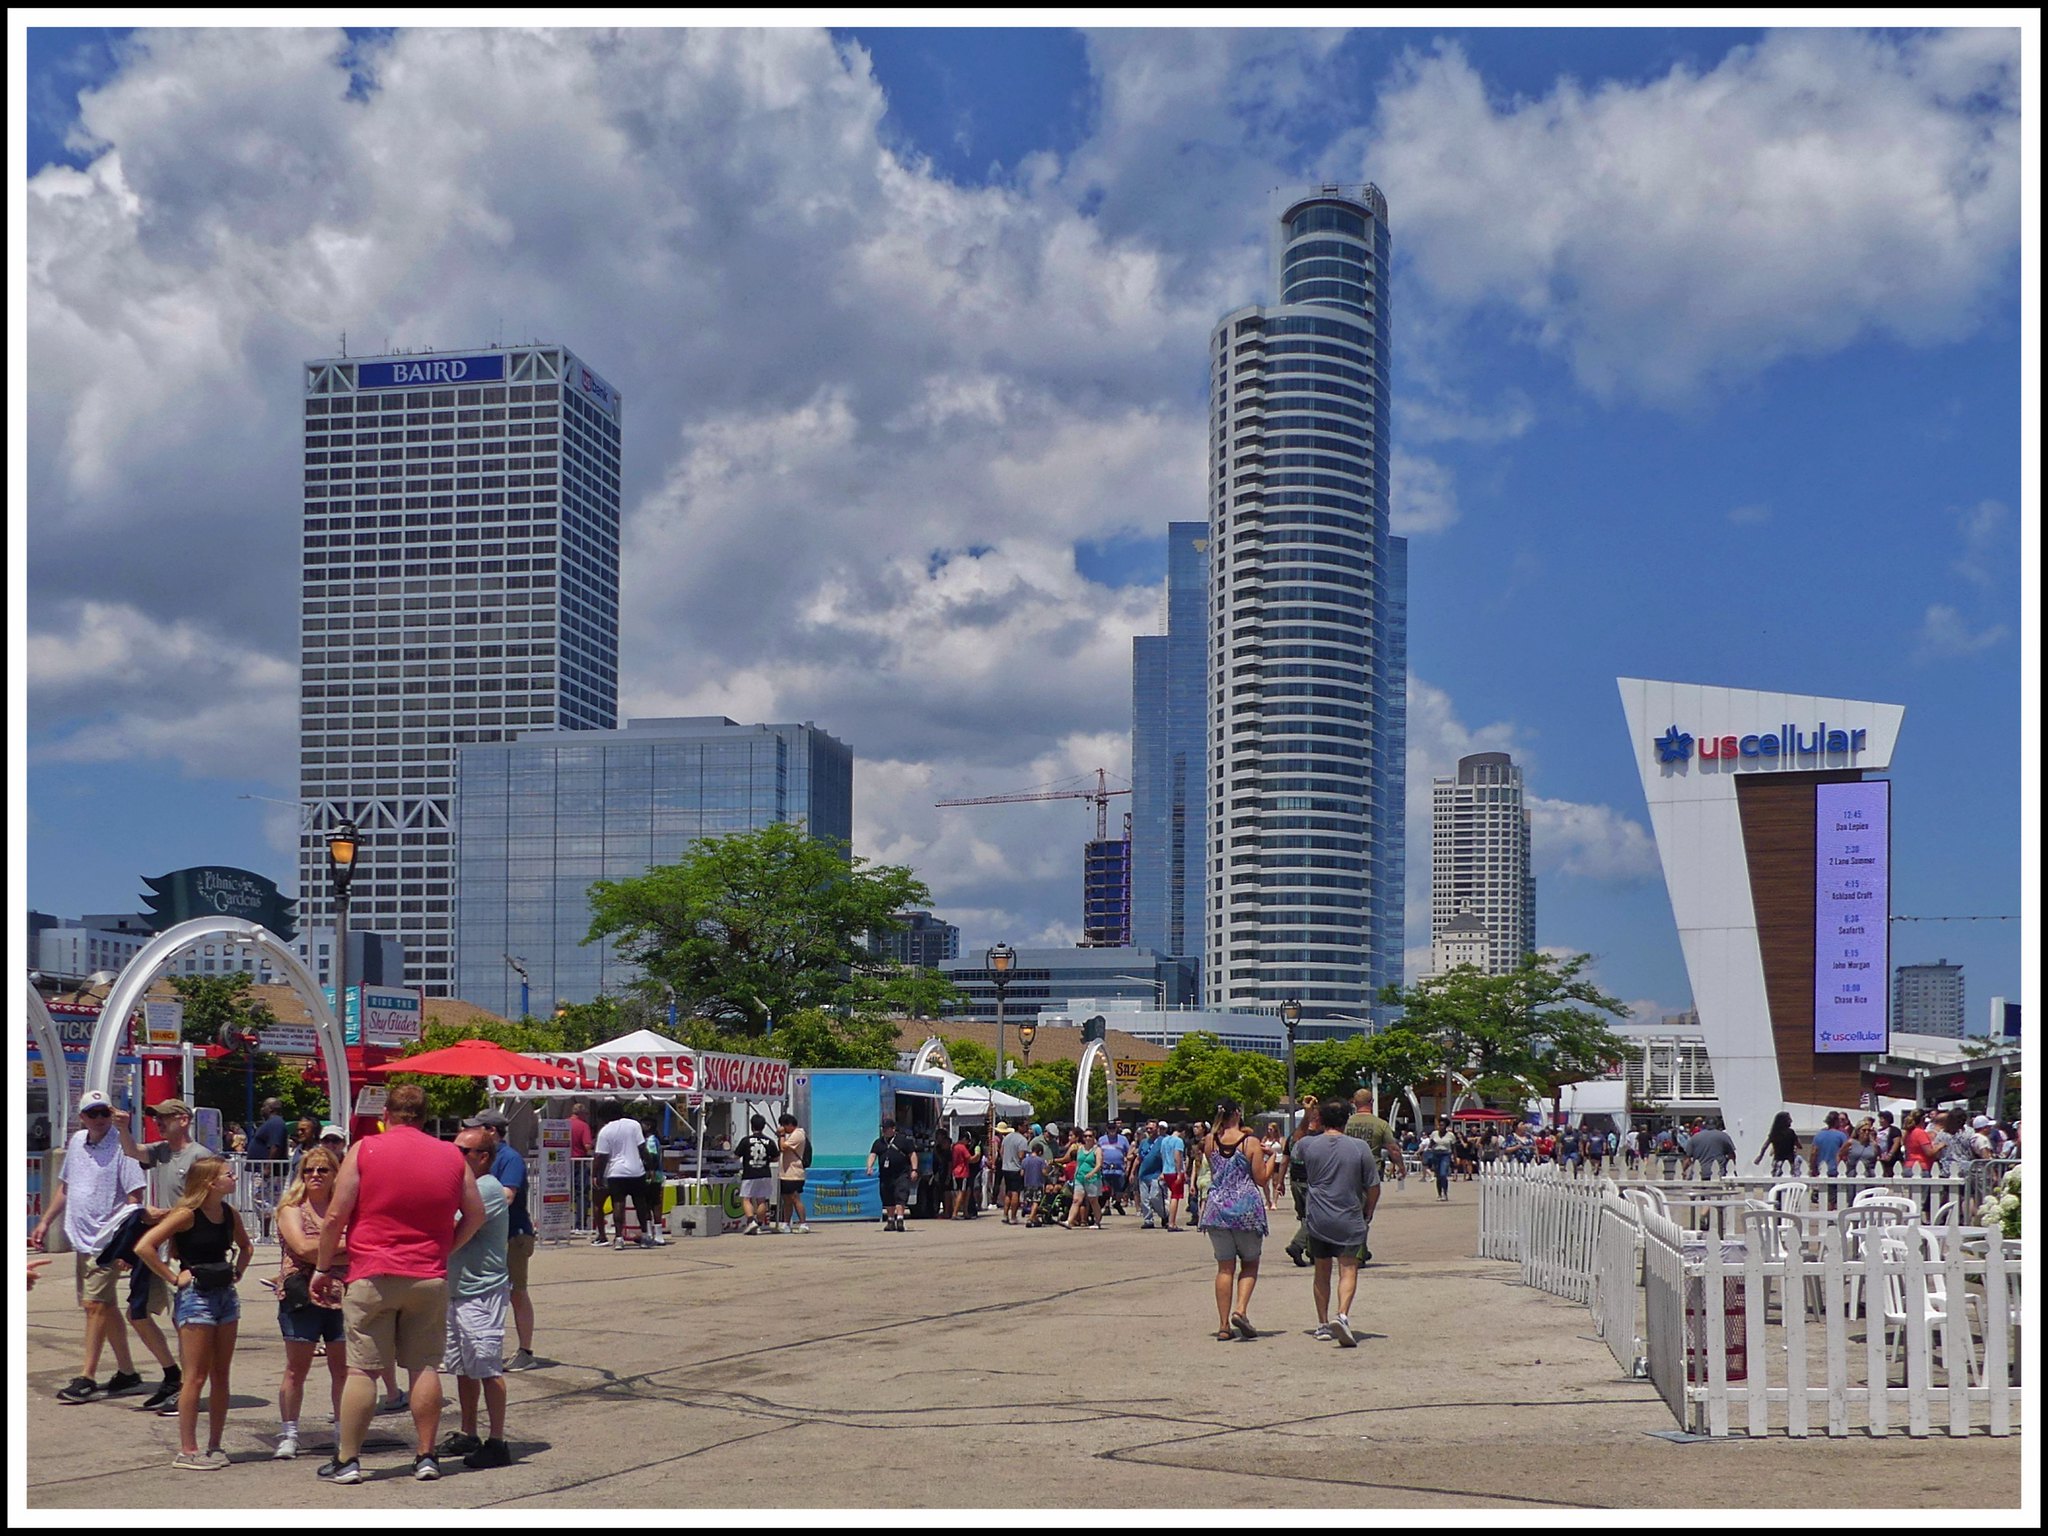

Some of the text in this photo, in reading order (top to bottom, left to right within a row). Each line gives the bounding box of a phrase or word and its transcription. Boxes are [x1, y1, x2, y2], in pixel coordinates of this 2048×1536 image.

[393, 360, 468, 383] BAIRD
[1698, 721, 1866, 761] uscellular
[1843, 810, 1862, 819] 12:45
[1835, 823, 1848, 831] Dan
[1834, 858, 1849, 866] Lane
[1850, 857, 1876, 866] Summer
[204, 871, 239, 891] Ethnic
[1844, 880, 1860, 888] 4:15
[213, 890, 263, 912] Gardens
[1832, 891, 1873, 901] Ashland Craft
[1838, 926, 1865, 935] Seaforth
[1832, 961, 1871, 971] John Morgan
[371, 996, 413, 1009] RIDE THE
[1834, 995, 1868, 1005] Chase Rice
[1832, 1030, 1883, 1041] uscellular
[704, 1056, 787, 1096] SUNGLASSES
